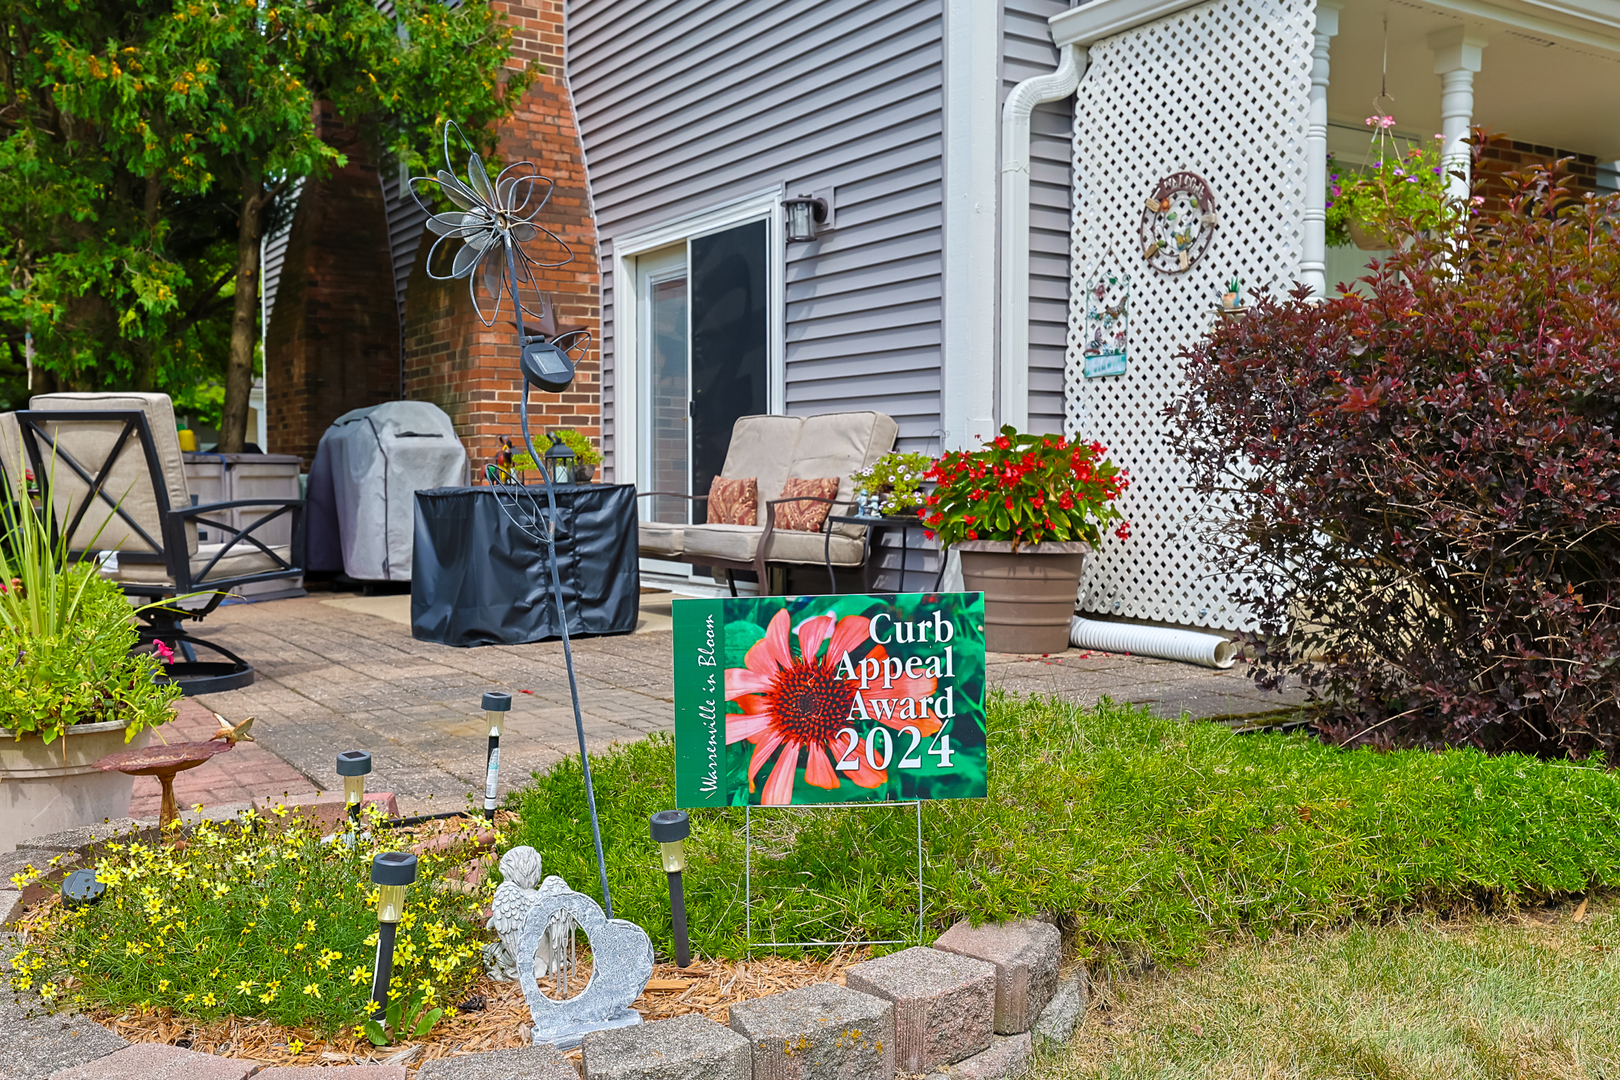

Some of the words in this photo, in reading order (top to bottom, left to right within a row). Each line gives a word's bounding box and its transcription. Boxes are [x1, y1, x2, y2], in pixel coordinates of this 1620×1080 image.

[697, 614, 717, 667] Bloom
[868, 610, 954, 644] Curb
[702, 673, 716, 693] in
[834, 646, 955, 690] Appeal
[846, 687, 956, 721] Award
[699, 699, 718, 792] Warrenville
[835, 720, 955, 771] 2024
